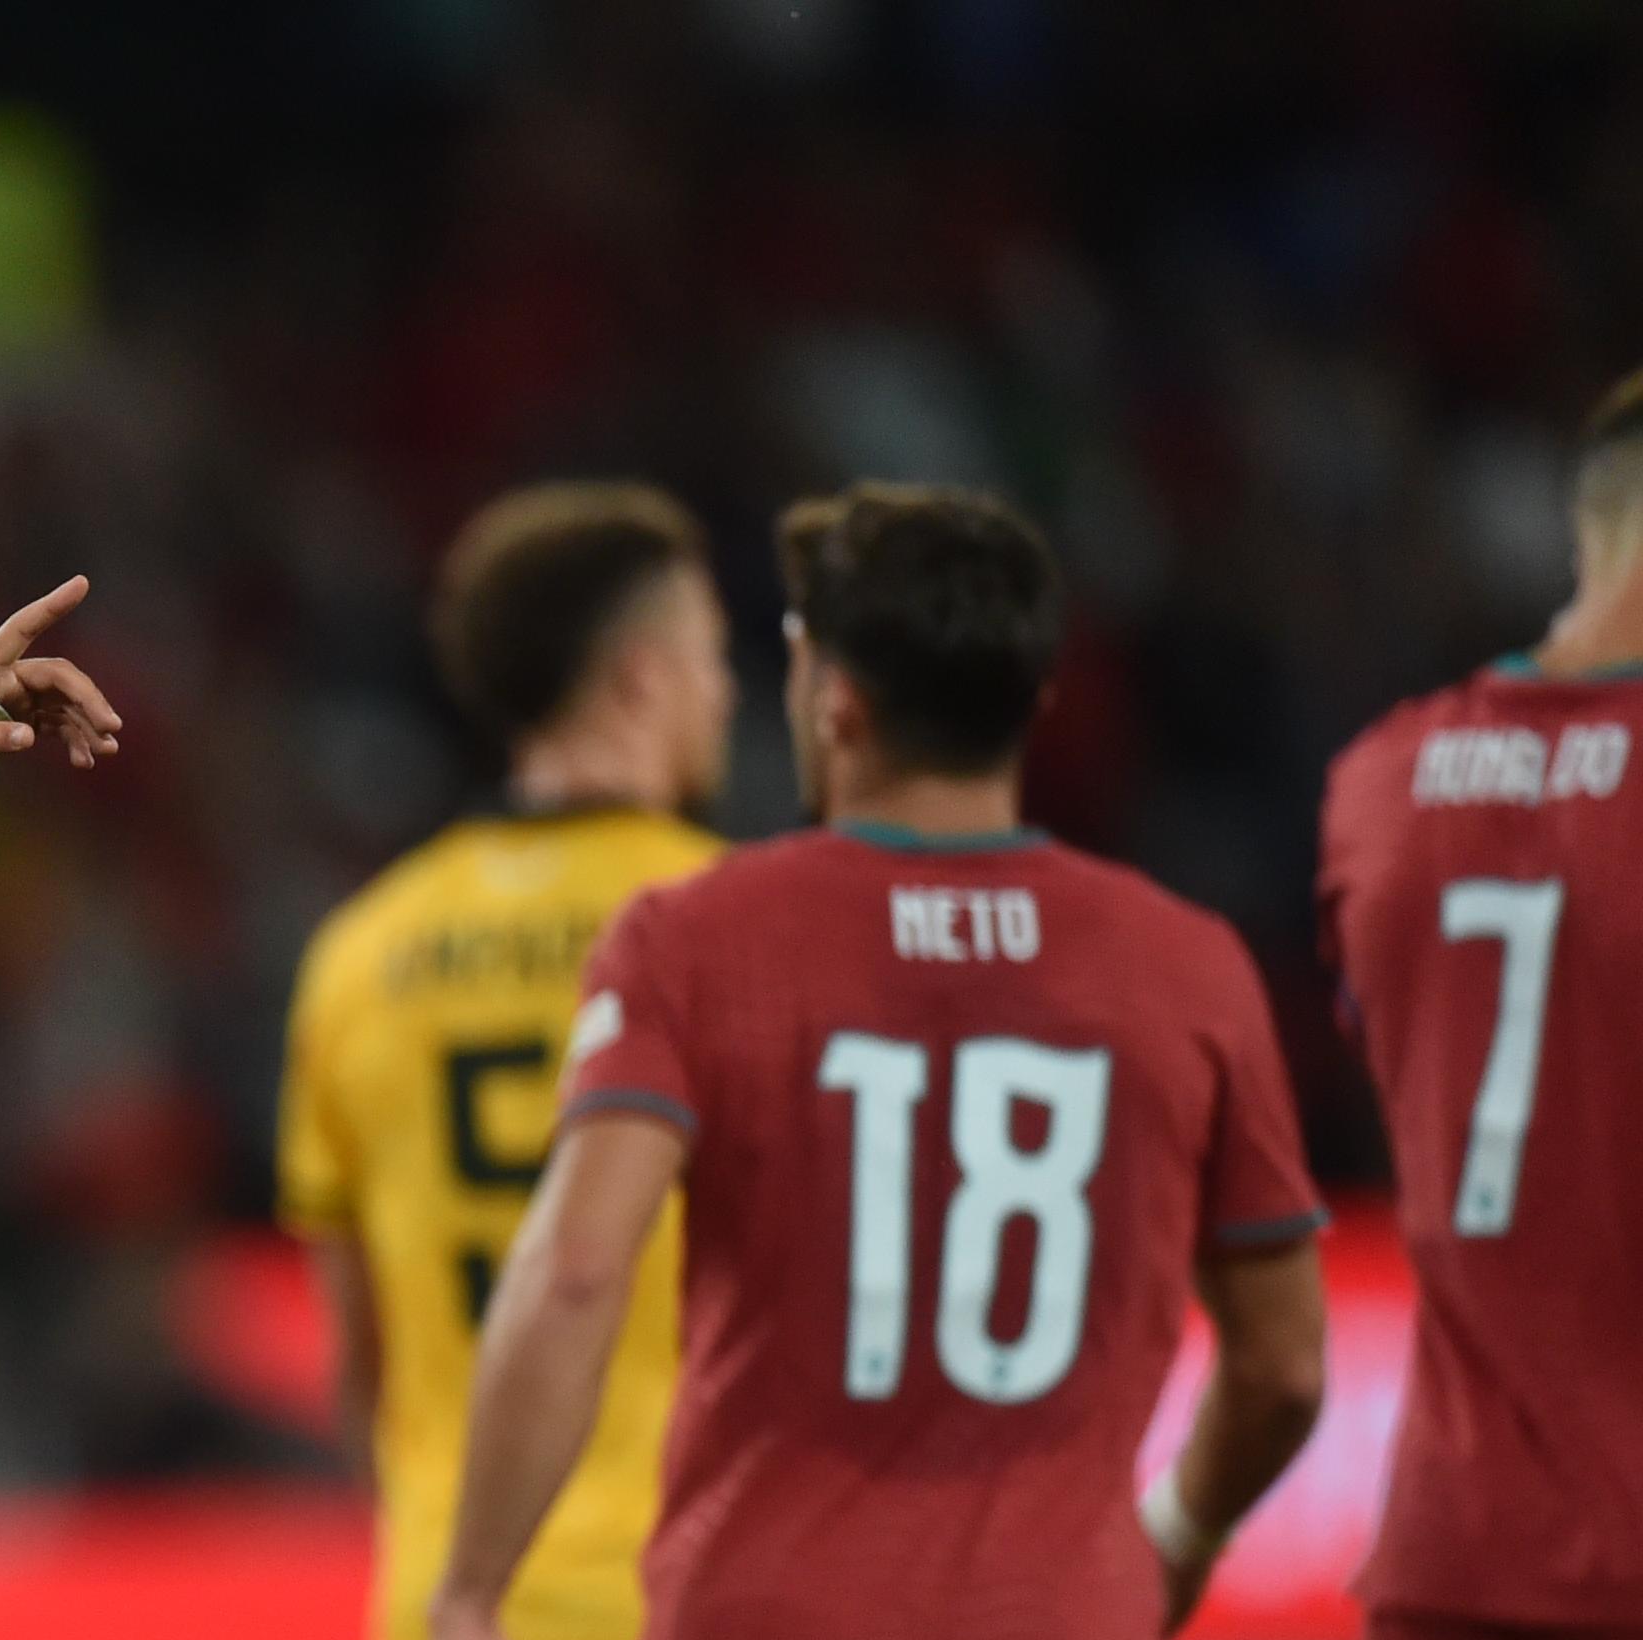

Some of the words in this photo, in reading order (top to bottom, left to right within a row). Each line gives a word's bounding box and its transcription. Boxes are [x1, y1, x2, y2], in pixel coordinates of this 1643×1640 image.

[889, 886, 1040, 962] NETO
[1440, 876, 1564, 1237] 7
[817, 1031, 1110, 1403] 18
